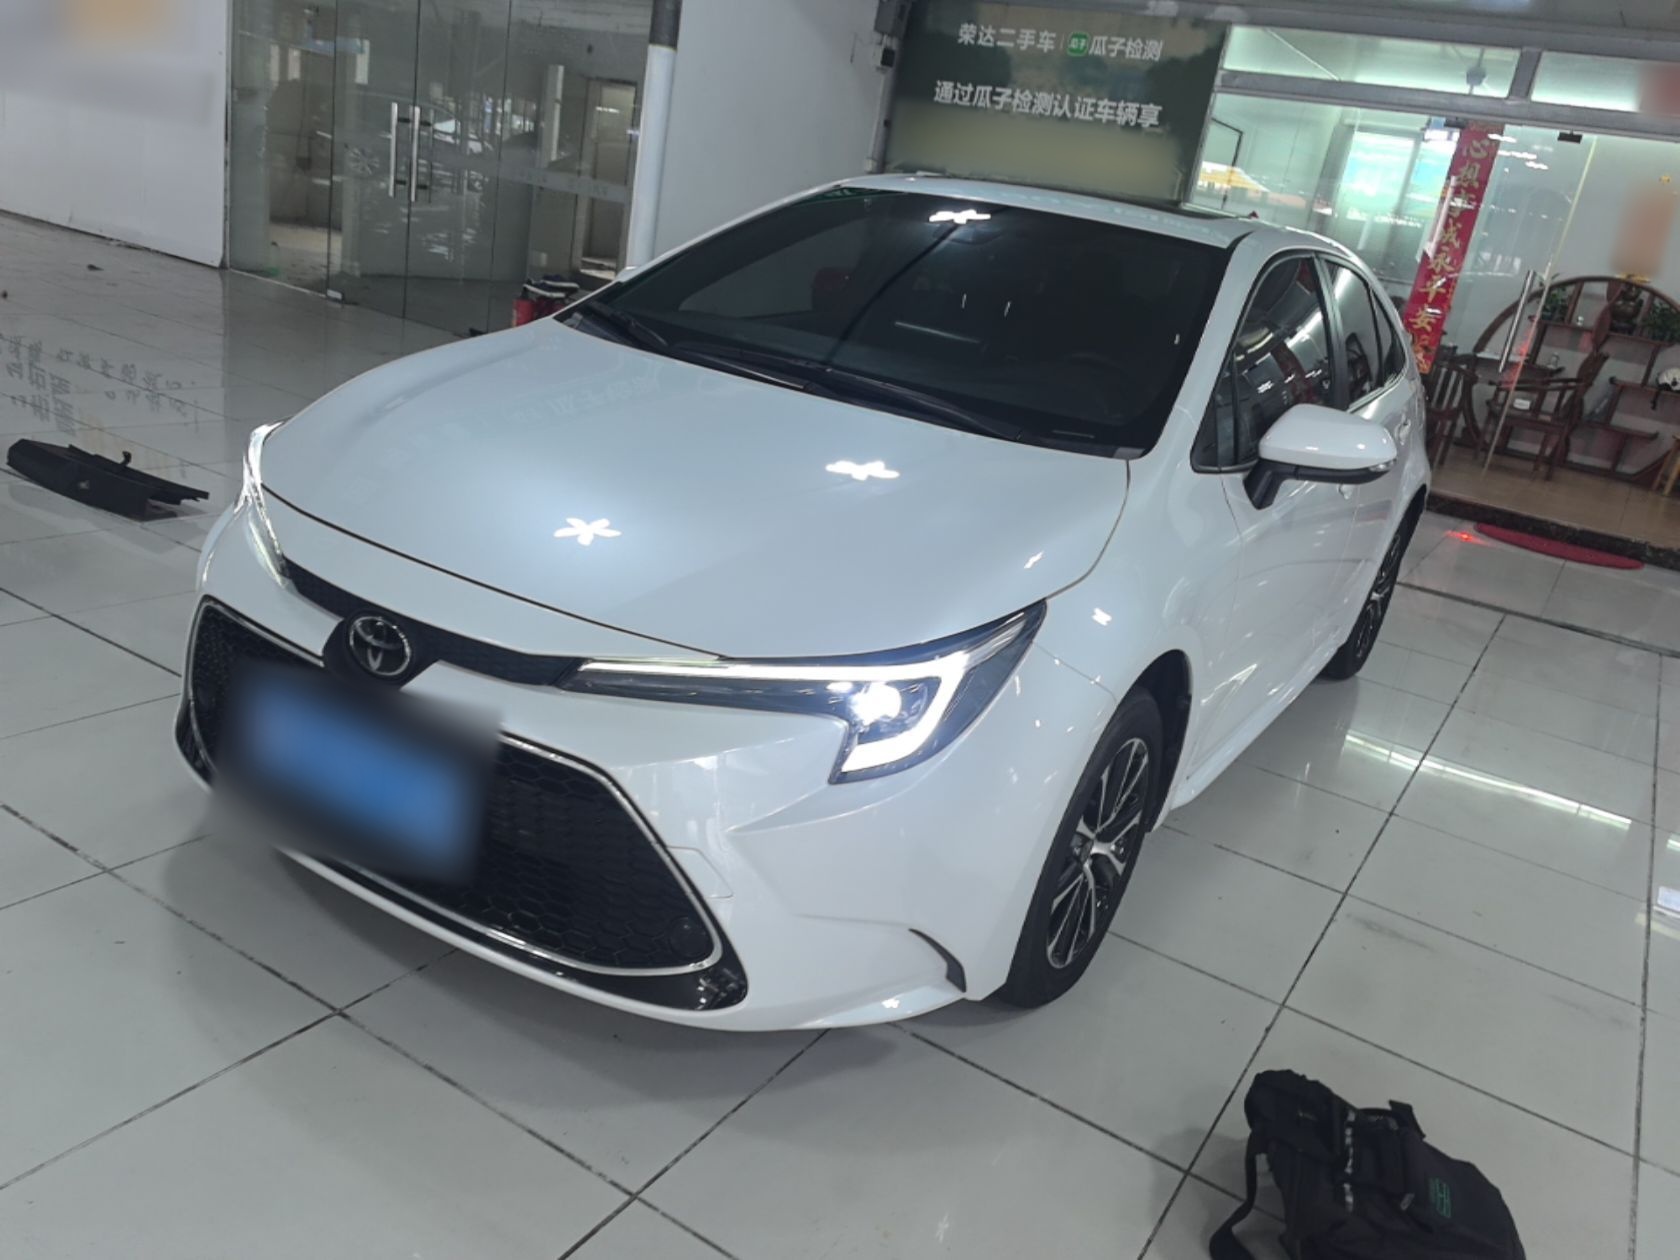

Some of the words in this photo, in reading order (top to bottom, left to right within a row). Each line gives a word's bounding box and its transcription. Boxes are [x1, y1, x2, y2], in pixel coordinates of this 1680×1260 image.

[958, 24, 1056, 53] 荣达二手车
[1088, 35, 1164, 61] 瓜子检测
[934, 81, 1163, 128] 通过瓜子检测认证车辆享
